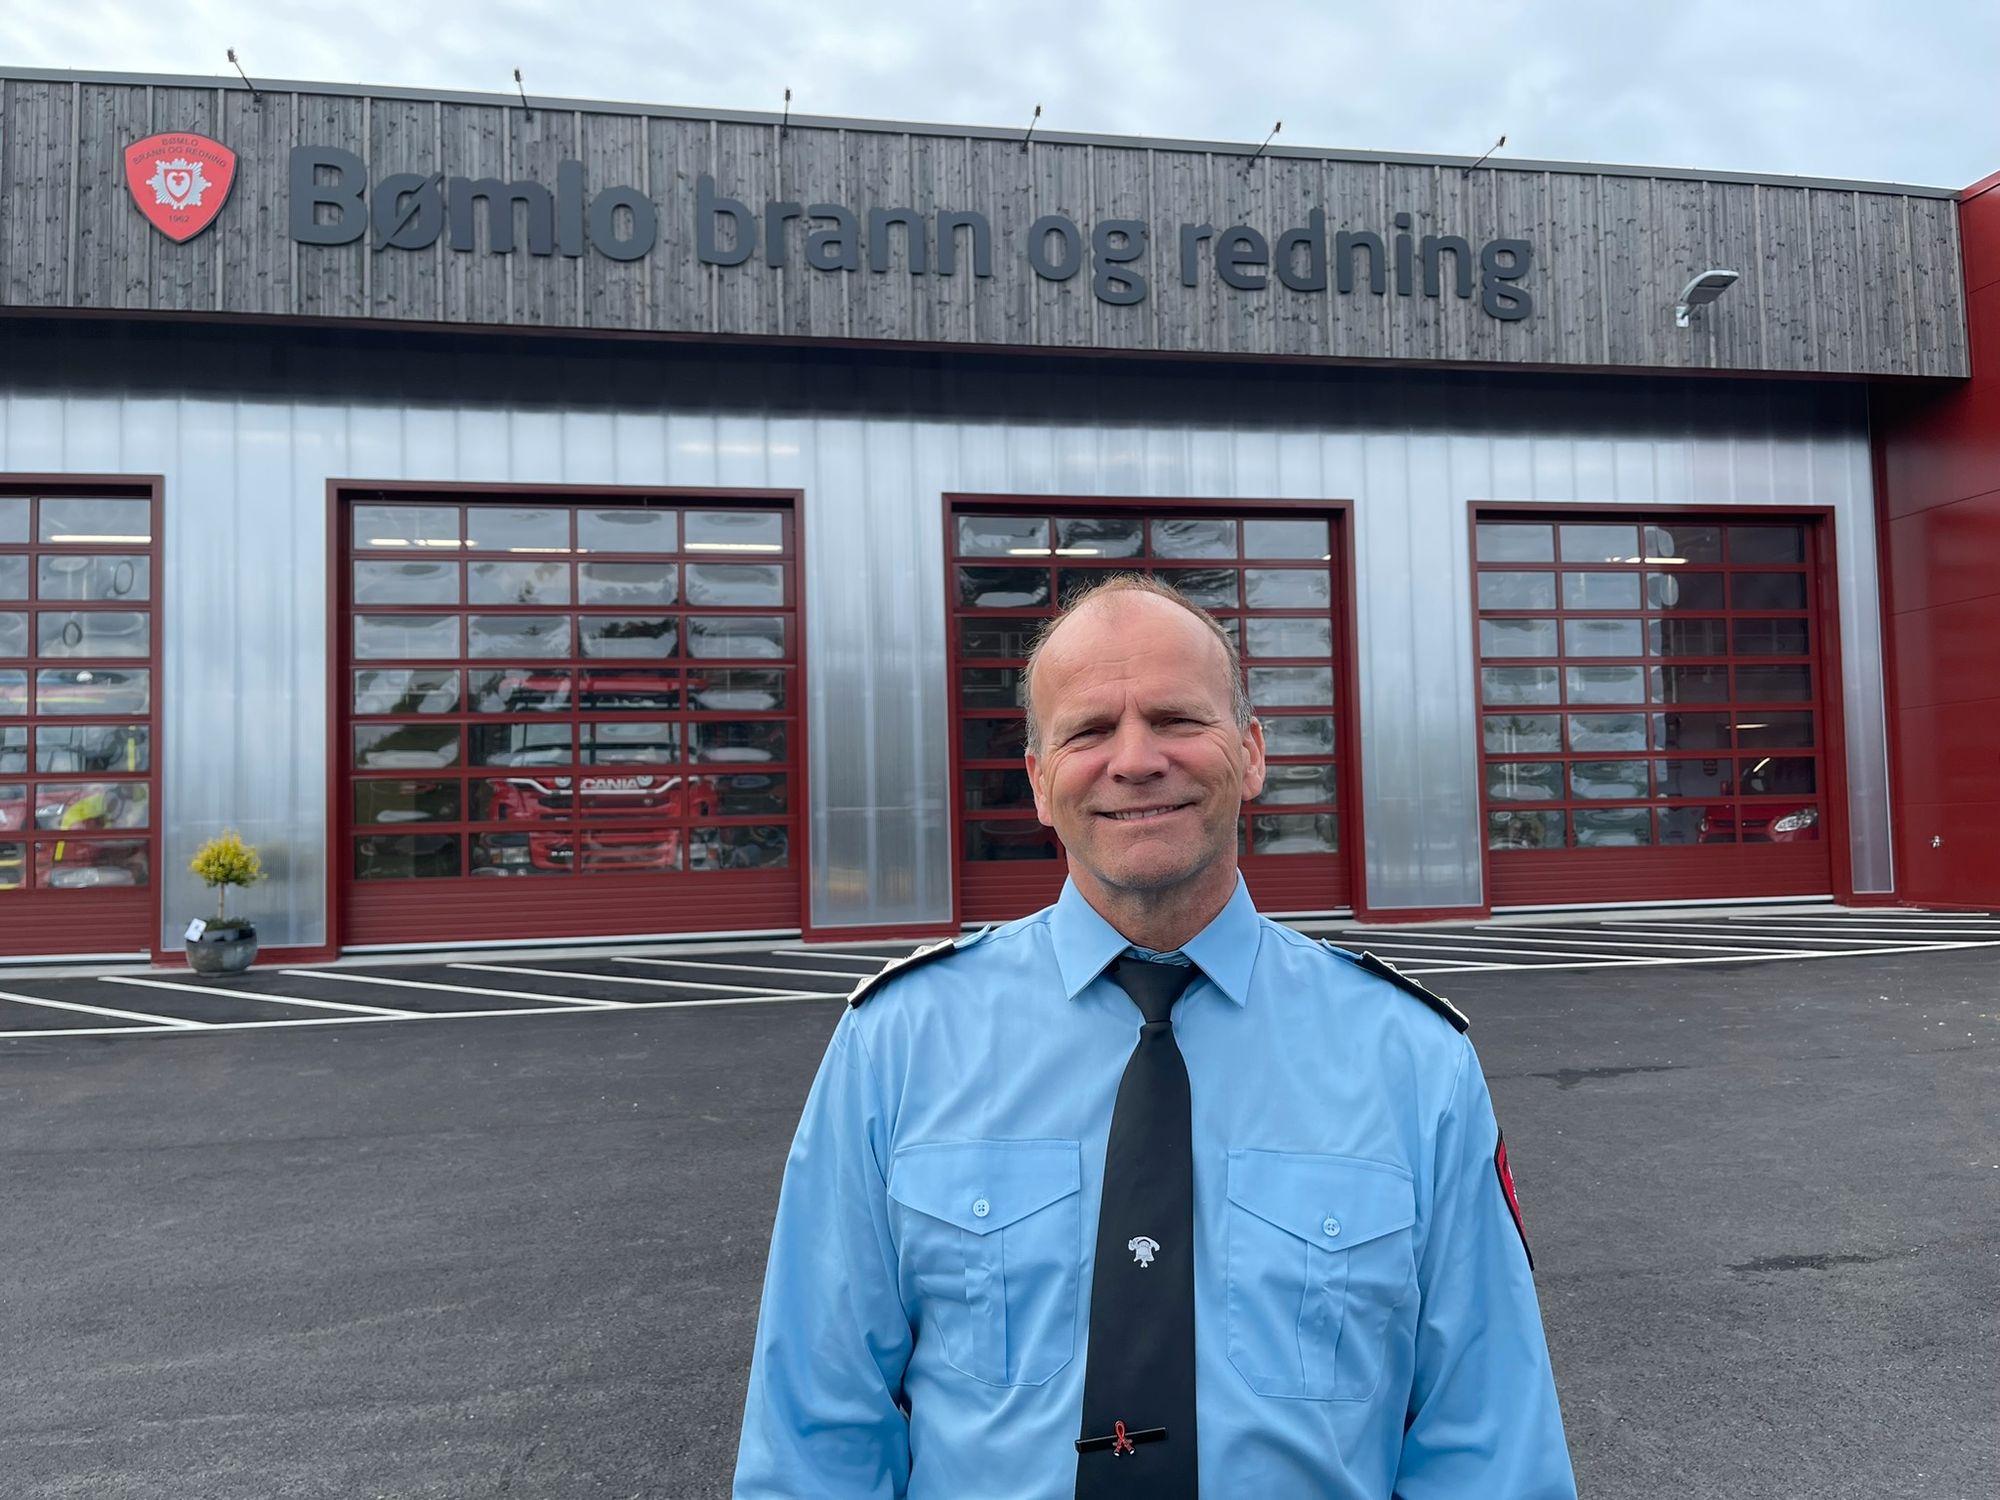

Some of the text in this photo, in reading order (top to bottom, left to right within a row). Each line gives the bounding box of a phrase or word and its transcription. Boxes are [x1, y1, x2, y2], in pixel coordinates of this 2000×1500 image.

[132, 146, 228, 168] BRANN OG REDNING
[289, 145, 1533, 321] Bømlo brann og redning
[580, 778, 640, 790] CANIA
